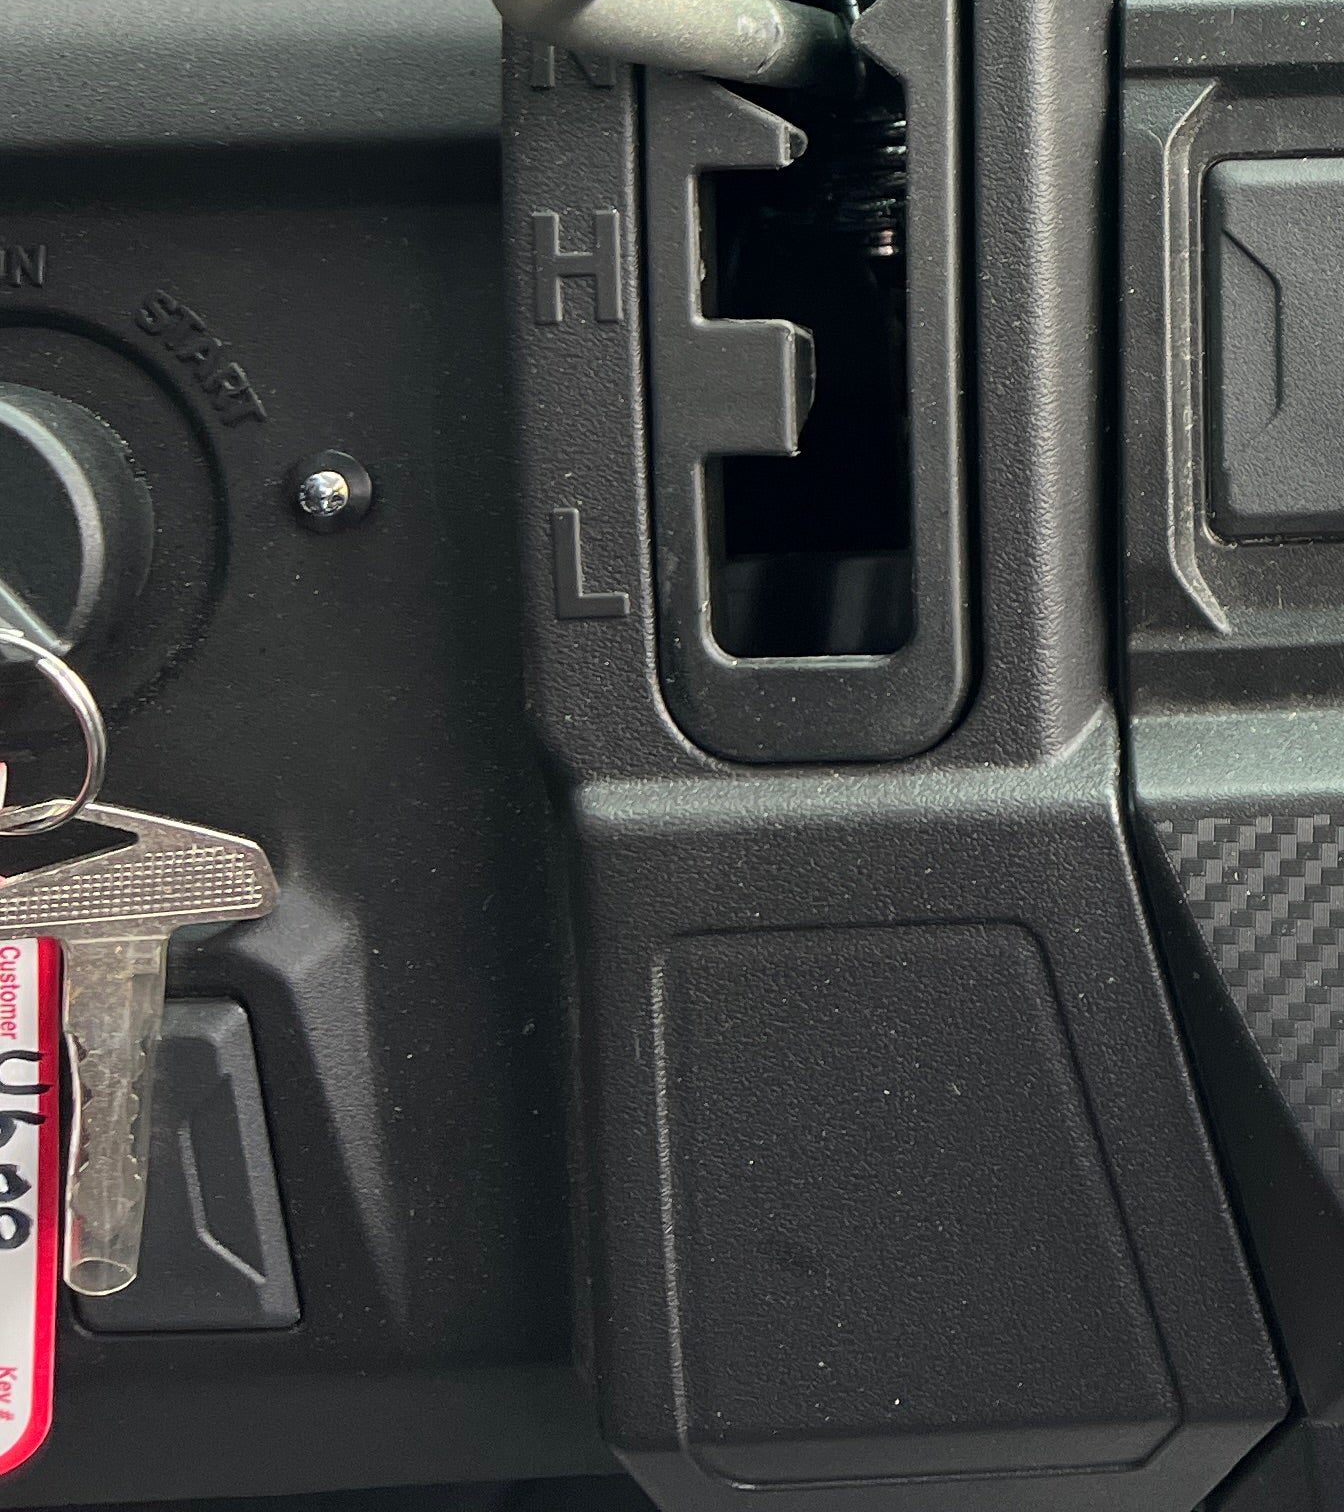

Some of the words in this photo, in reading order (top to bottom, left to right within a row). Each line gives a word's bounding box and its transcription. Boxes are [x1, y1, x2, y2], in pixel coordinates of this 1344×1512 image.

[0, 245, 48, 287] N
[530, 208, 624, 324] H
[134, 288, 268, 429] START
[552, 507, 631, 621] L
[0, 945, 21, 1041] Customer
